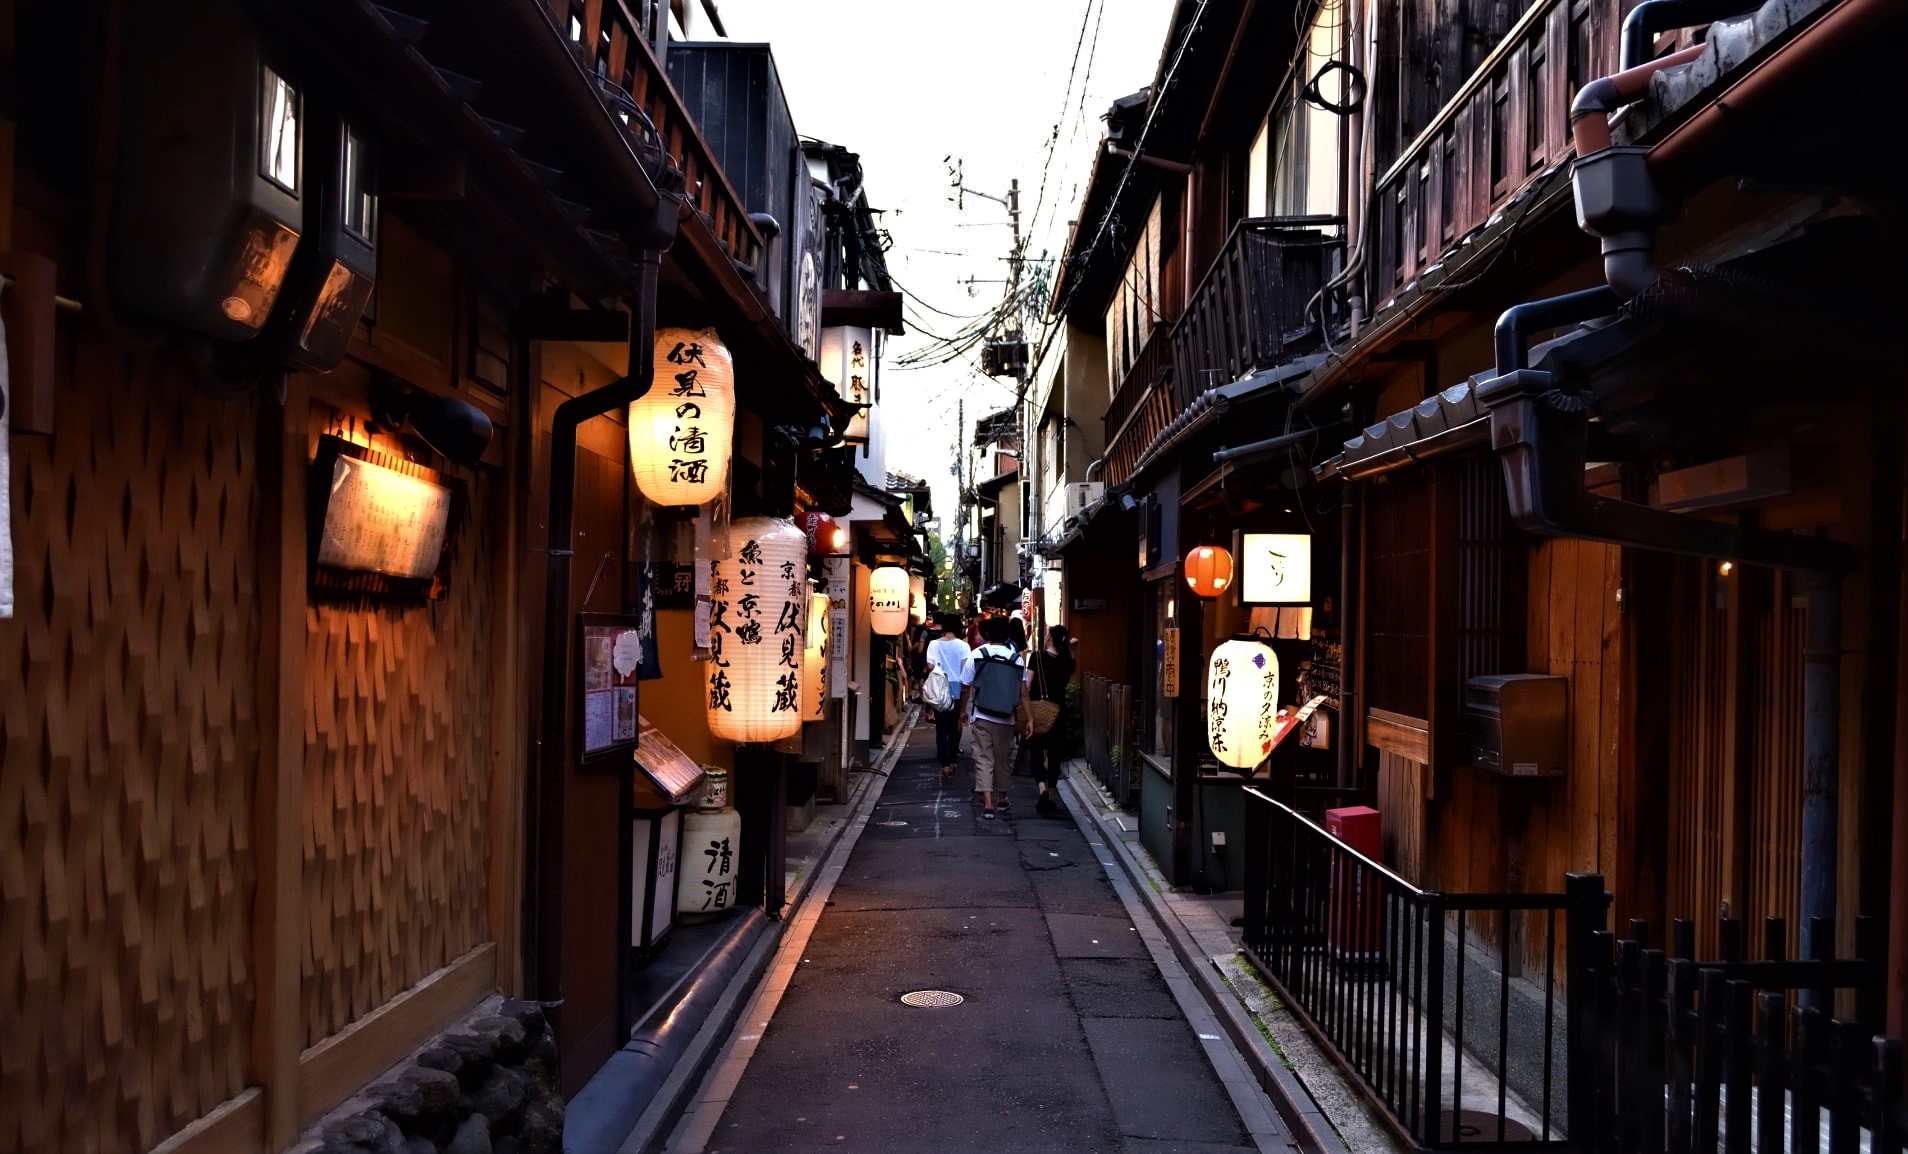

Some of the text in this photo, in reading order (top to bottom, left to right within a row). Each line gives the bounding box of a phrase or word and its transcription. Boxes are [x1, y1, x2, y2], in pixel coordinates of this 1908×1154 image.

[666, 341, 709, 485] 伏見の清酒
[1210, 657, 1232, 753] 鴨川納涼床
[1258, 671, 1275, 741] 京の夕涼み
[703, 836, 733, 911] 清酒
